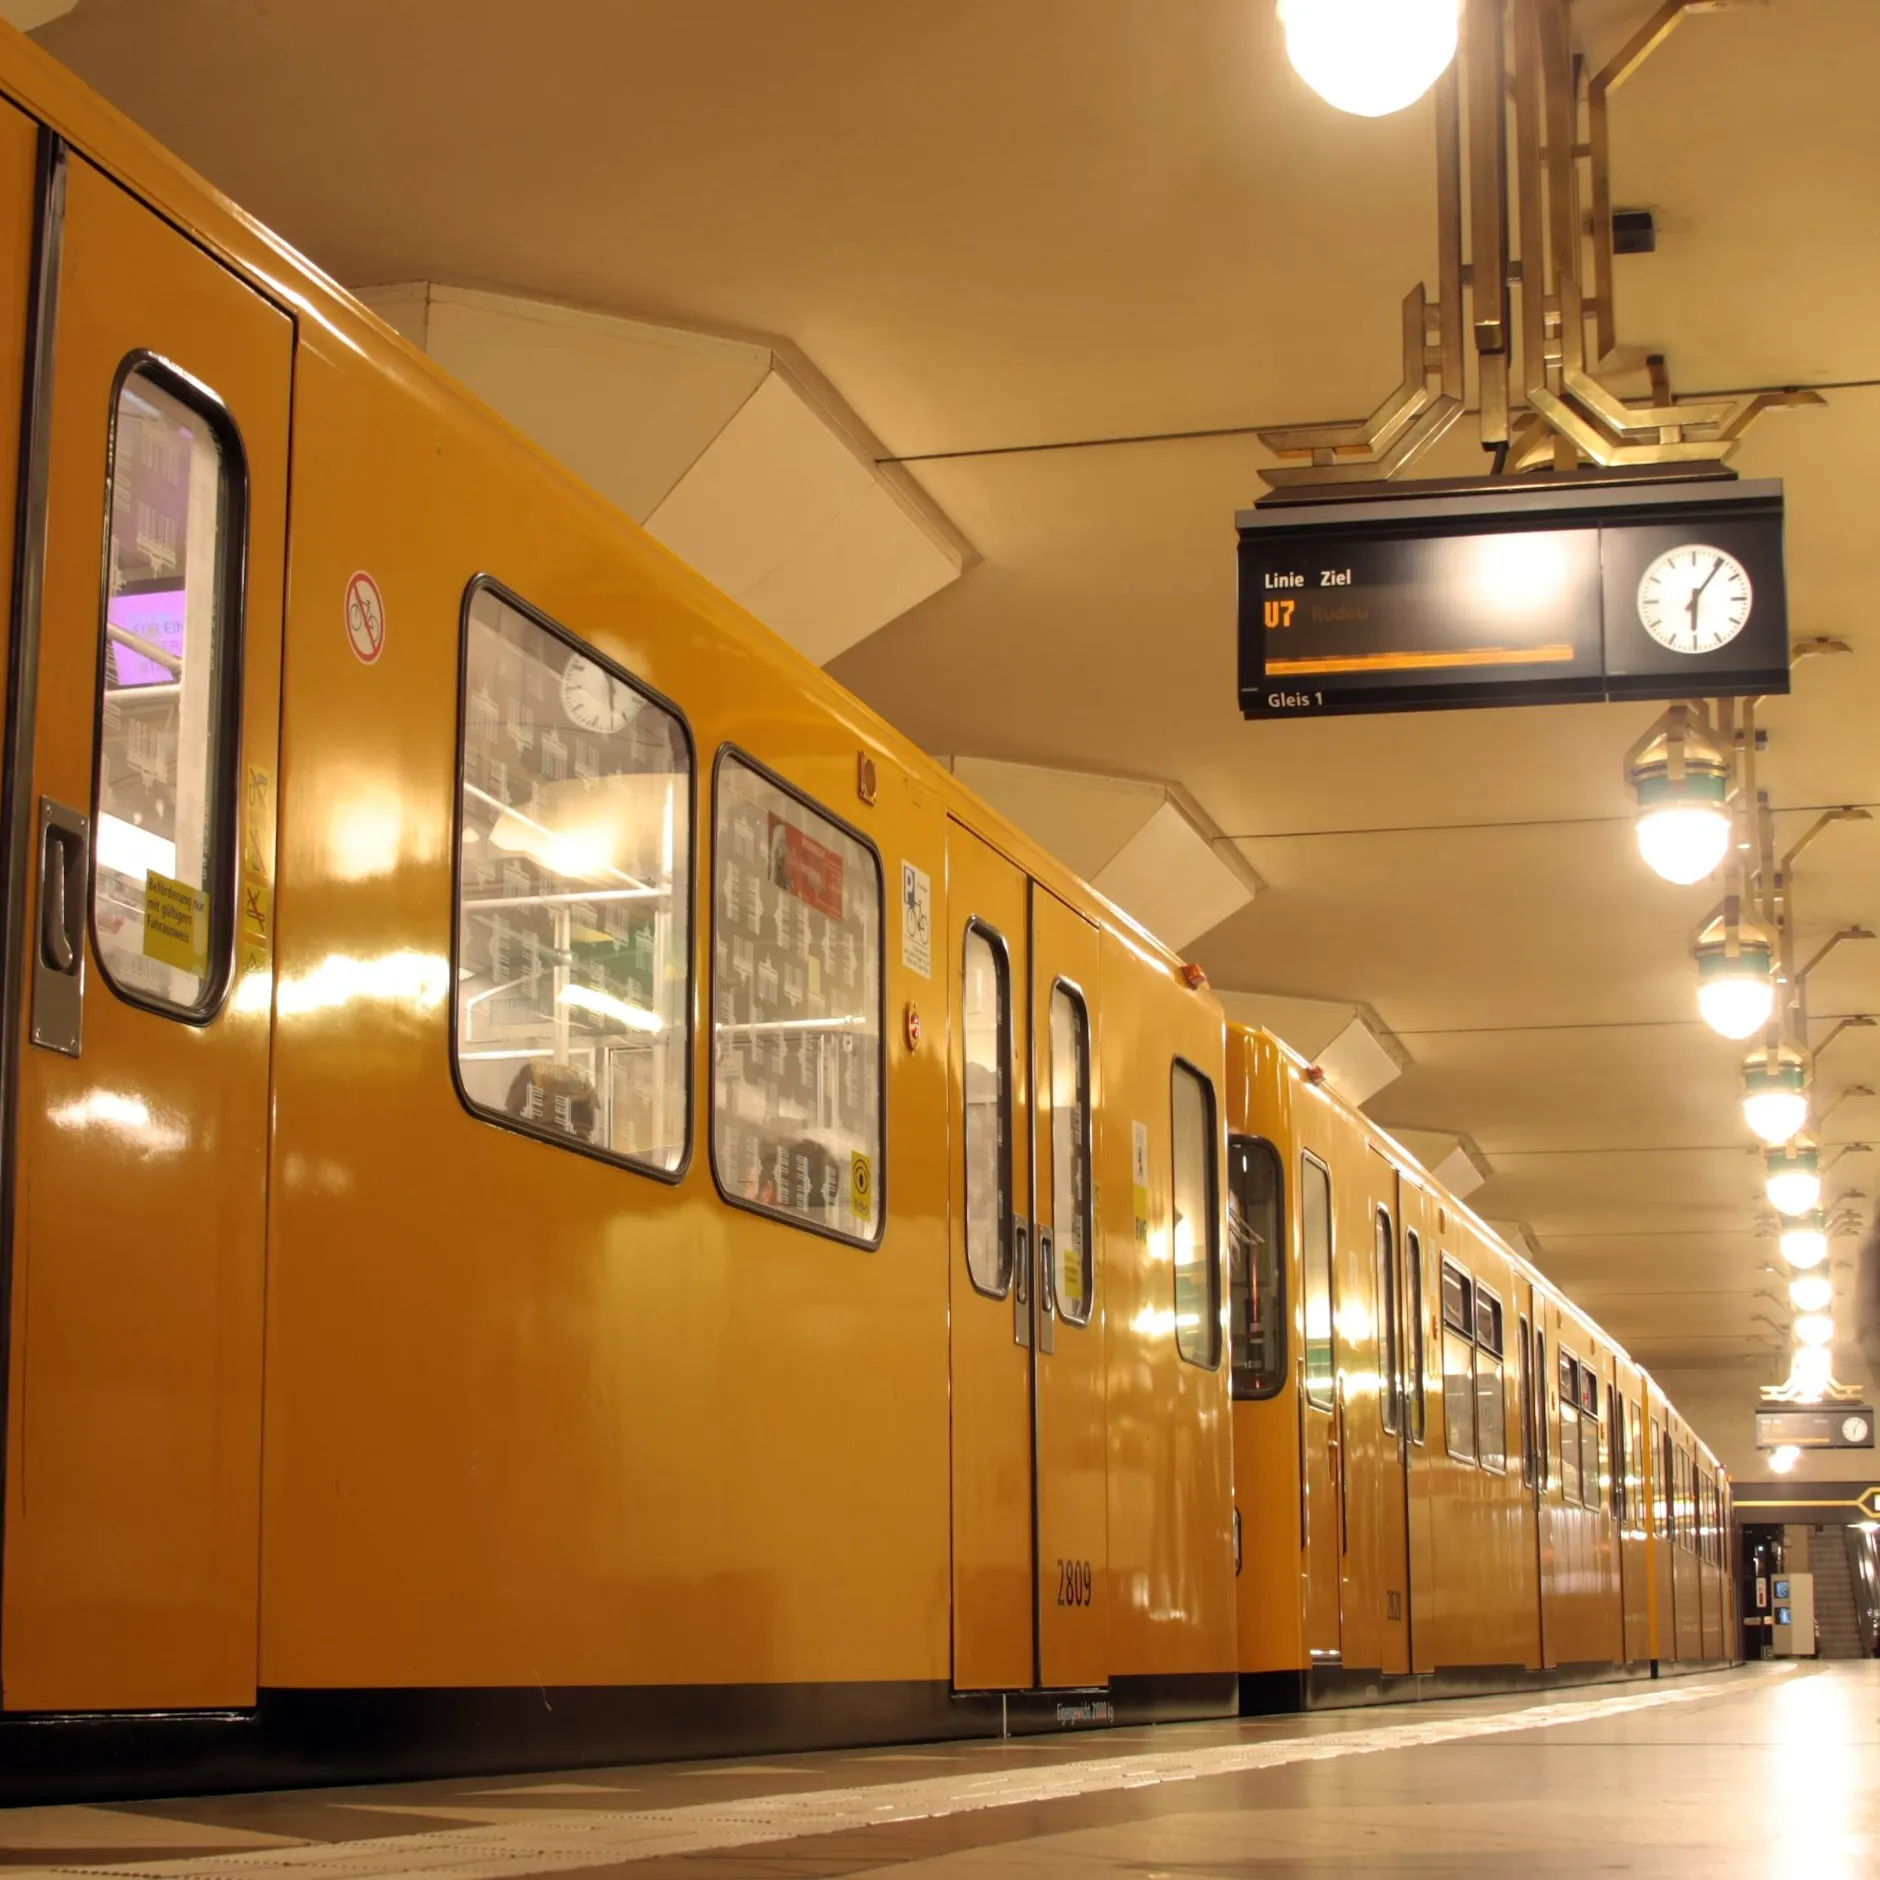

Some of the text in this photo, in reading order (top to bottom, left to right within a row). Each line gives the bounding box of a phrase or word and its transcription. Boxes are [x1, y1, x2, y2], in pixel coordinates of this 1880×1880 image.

[1264, 568, 1352, 589] Linie Ziel
[1264, 600, 1295, 628] U7
[1267, 691, 1323, 708] Gleis 1
[148, 876, 205, 913] Beförderung nur
[147, 898, 192, 925] mit gültigem
[854, 1196, 868, 1217] Video
[1057, 1559, 1091, 1607] 2809
